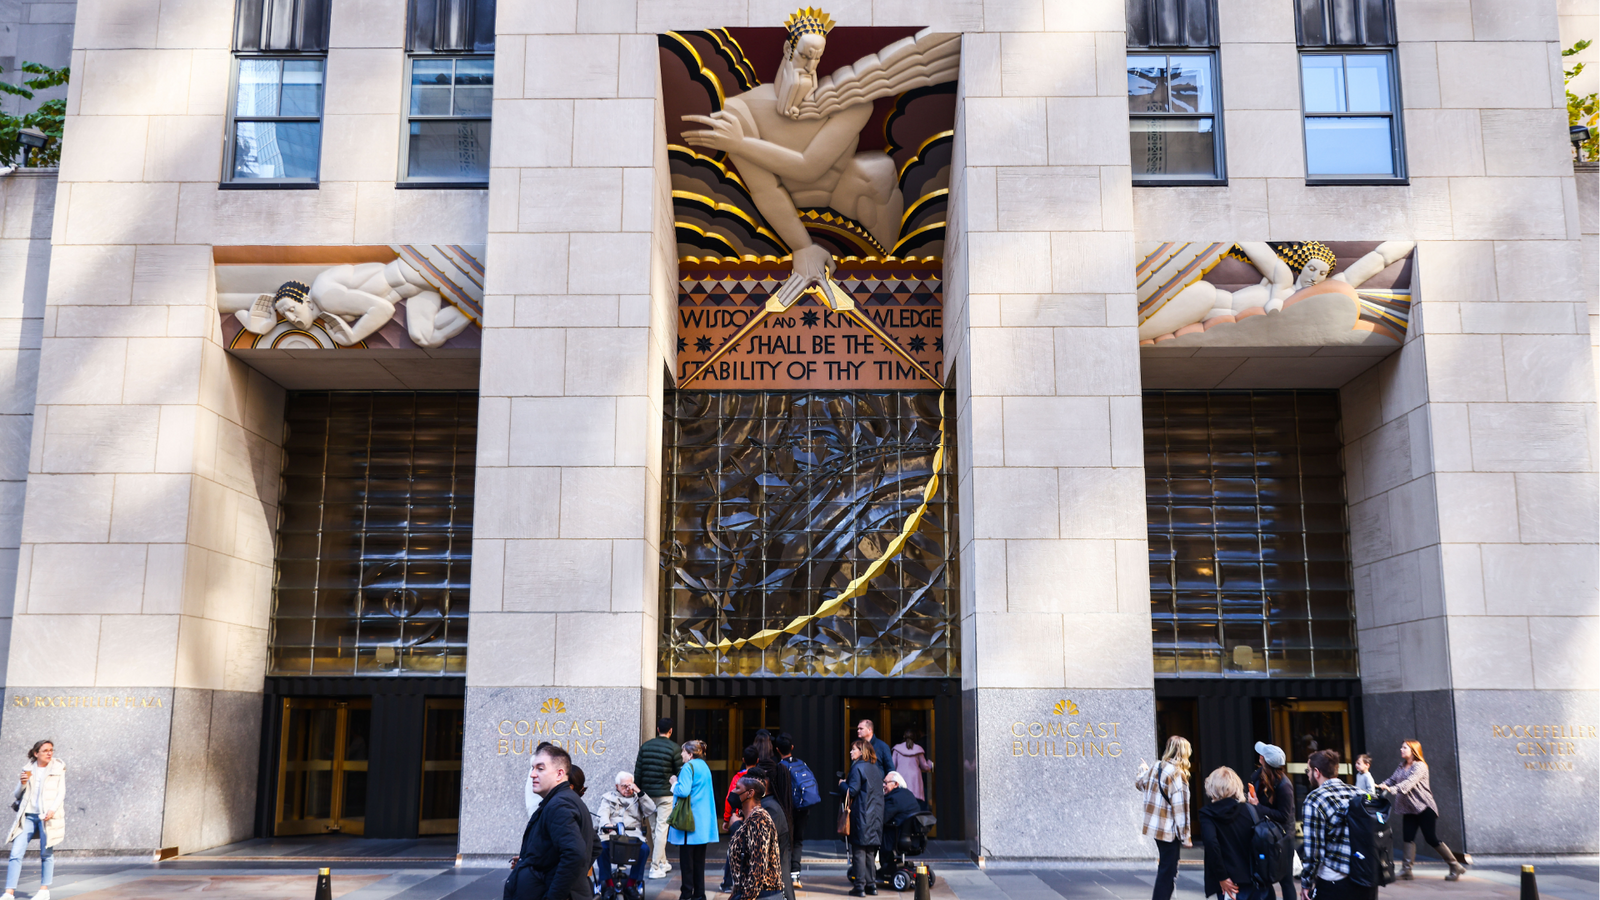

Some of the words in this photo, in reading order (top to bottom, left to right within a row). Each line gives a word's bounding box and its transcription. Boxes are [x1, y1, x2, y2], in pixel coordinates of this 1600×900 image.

[680, 309, 768, 328] WISDO
[772, 317, 796, 328] AND
[746, 335, 806, 354] SHALL
[812, 335, 835, 354] BE
[842, 335, 874, 354] THE
[678, 361, 783, 380] STABILITY
[786, 361, 817, 380] OF
[823, 361, 866, 380] THY
[12, 696, 30, 707] 30
[34, 696, 119, 707] ROCKEFELLER
[125, 696, 163, 707] PLAZA
[498, 720, 606, 736] COMCAST
[1011, 721, 1120, 738] COMCAST
[1492, 725, 1598, 739] ROCKEFELLER
[1012, 741, 1122, 757] BUILDING
[1516, 742, 1576, 756] CENTER
